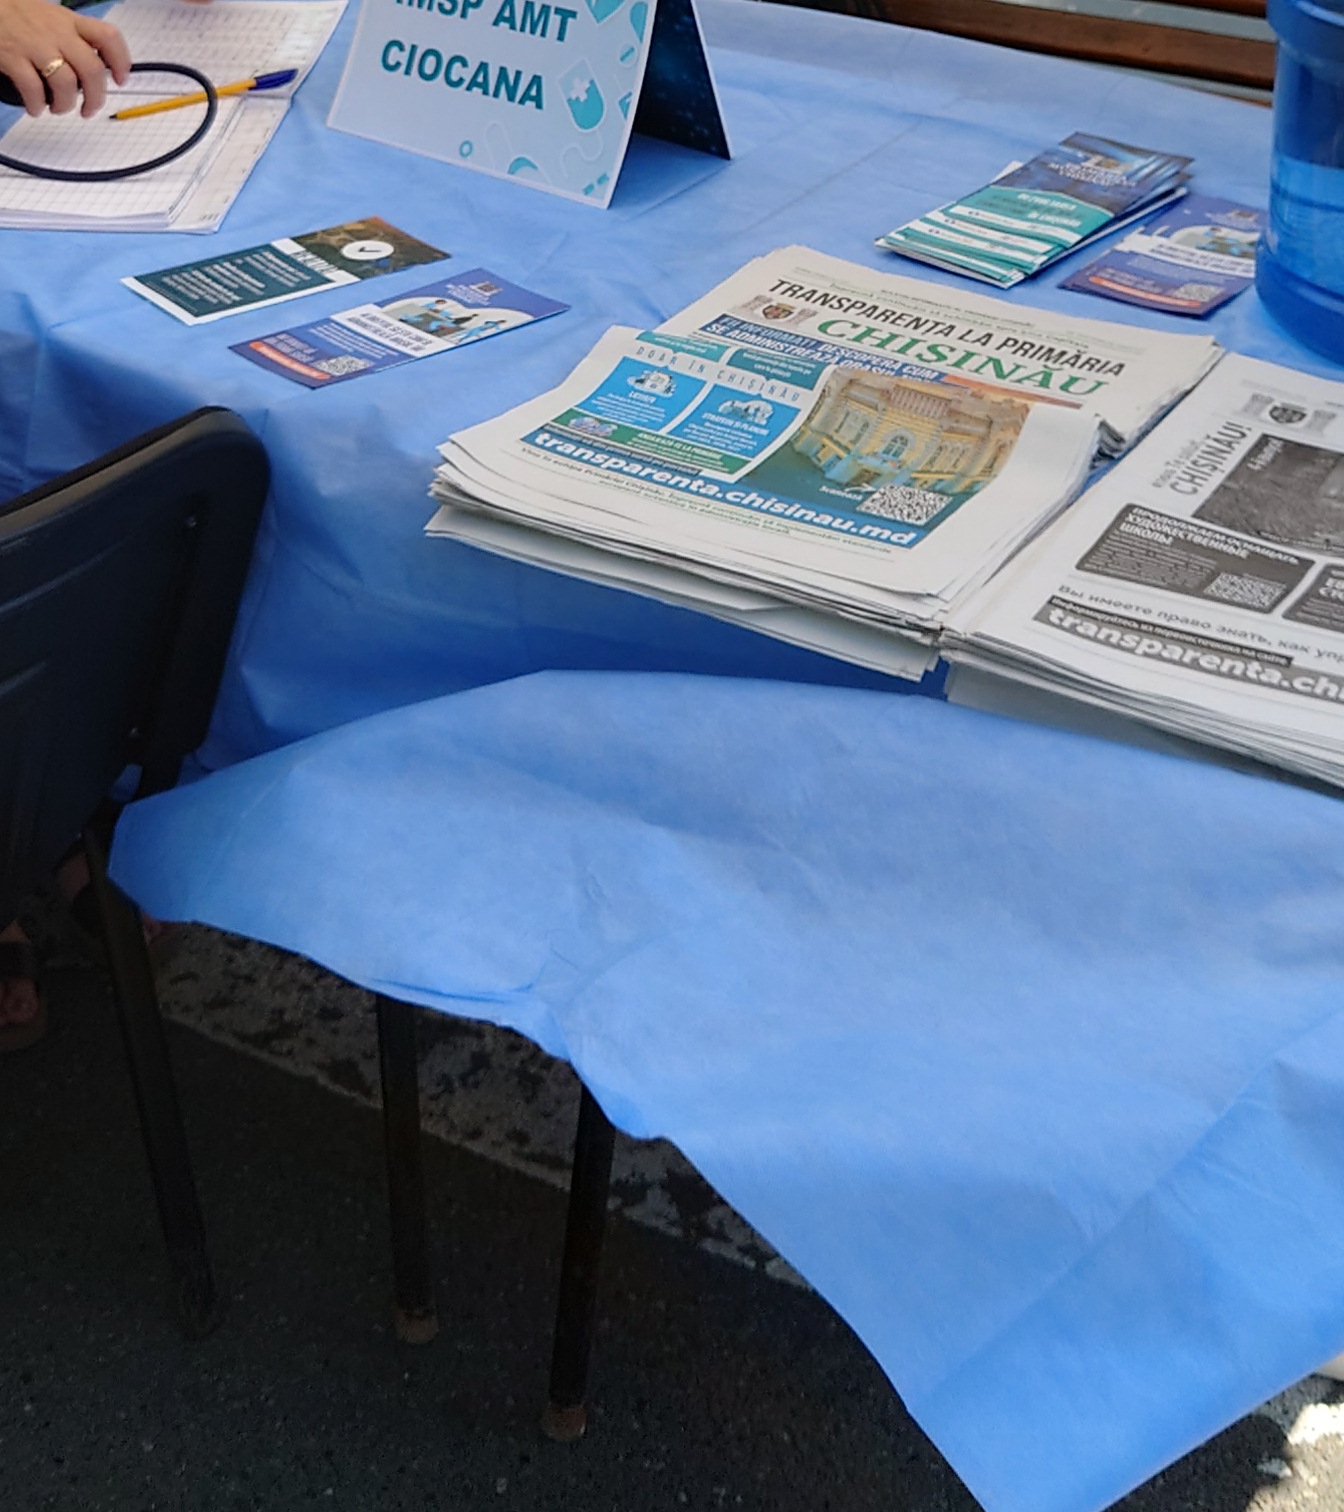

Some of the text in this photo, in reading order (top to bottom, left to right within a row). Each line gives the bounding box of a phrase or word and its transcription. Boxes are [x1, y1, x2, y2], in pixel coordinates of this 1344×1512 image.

[380, 39, 544, 111] CIOCANA
[635, 345, 677, 367] DOAR
[956, 328, 994, 347] LA
[994, 336, 1127, 377] PRIMĂRIA
[533, 430, 917, 548] transparenta.chisinau.md
[1118, 522, 1175, 546] ШКОЛЫ
[1157, 609, 1213, 631] право
